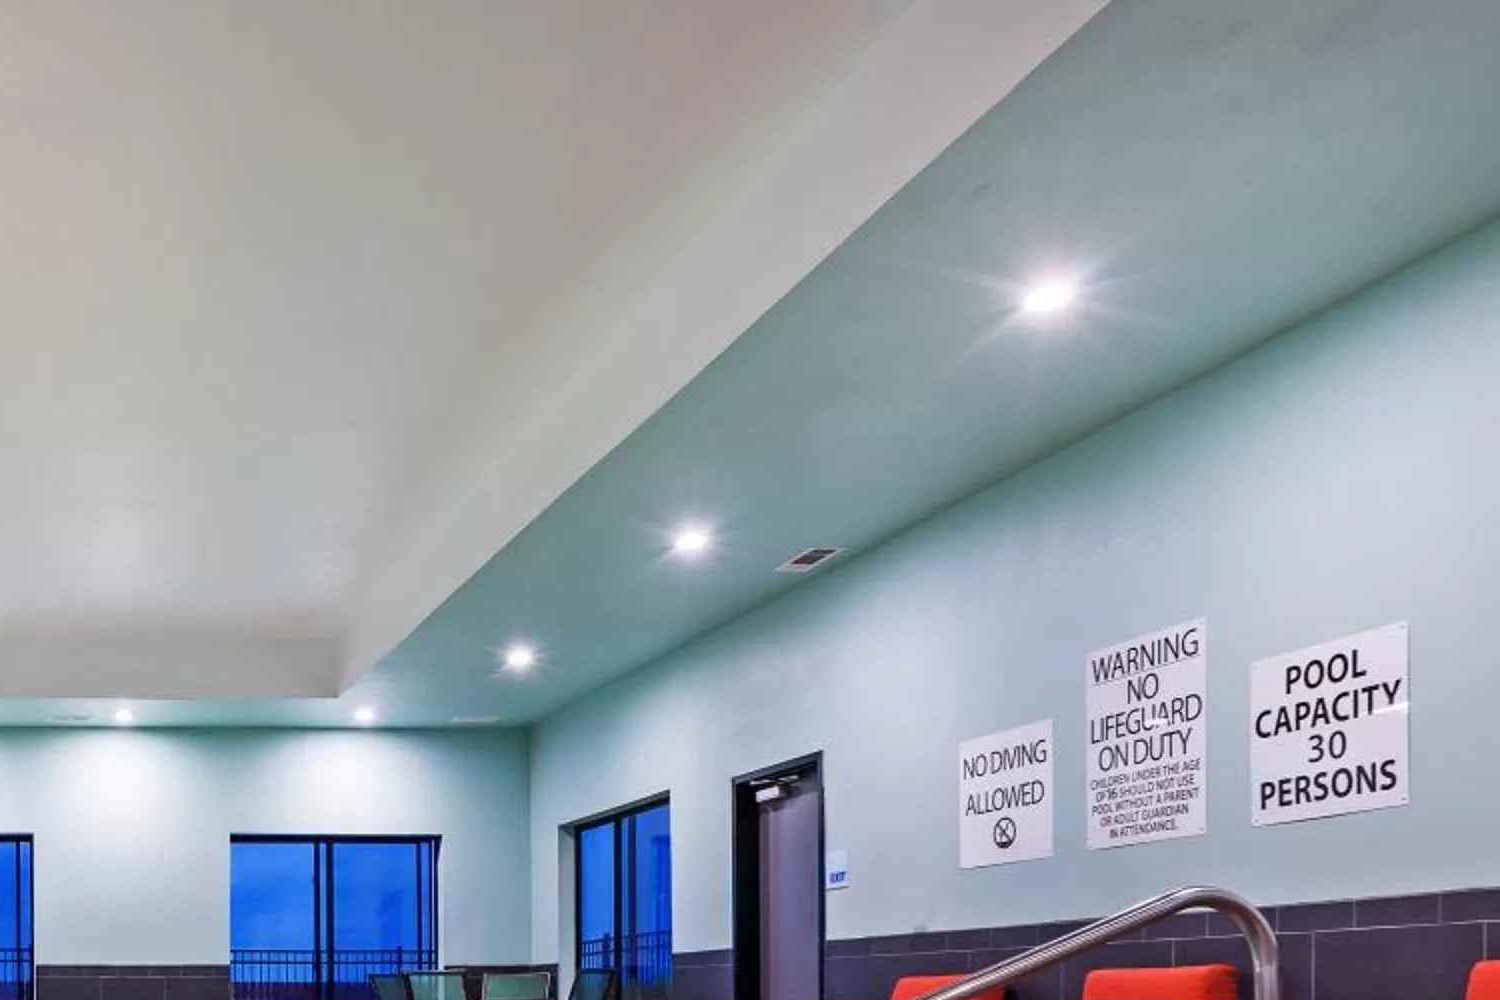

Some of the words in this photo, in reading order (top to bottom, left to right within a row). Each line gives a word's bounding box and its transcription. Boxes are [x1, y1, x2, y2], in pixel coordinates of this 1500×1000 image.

[1092, 628, 1199, 683] WARNING
[1285, 649, 1367, 695] POOL
[1127, 673, 1159, 704] NO
[1255, 678, 1401, 739] CAPACITY
[1090, 693, 1202, 744] LIFEGUARD
[963, 753, 987, 780] NO
[990, 739, 1047, 775] DIVING
[1098, 741, 1129, 772] ON
[1133, 727, 1193, 765] DUTY
[1163, 762, 1180, 776] THE
[1181, 757, 1201, 772] AGE
[1307, 730, 1347, 763] 30
[965, 779, 1045, 816] ALLOWED
[1156, 777, 1175, 791] NOT
[1156, 793, 1162, 804] A
[1260, 759, 1397, 810] PERSONS
